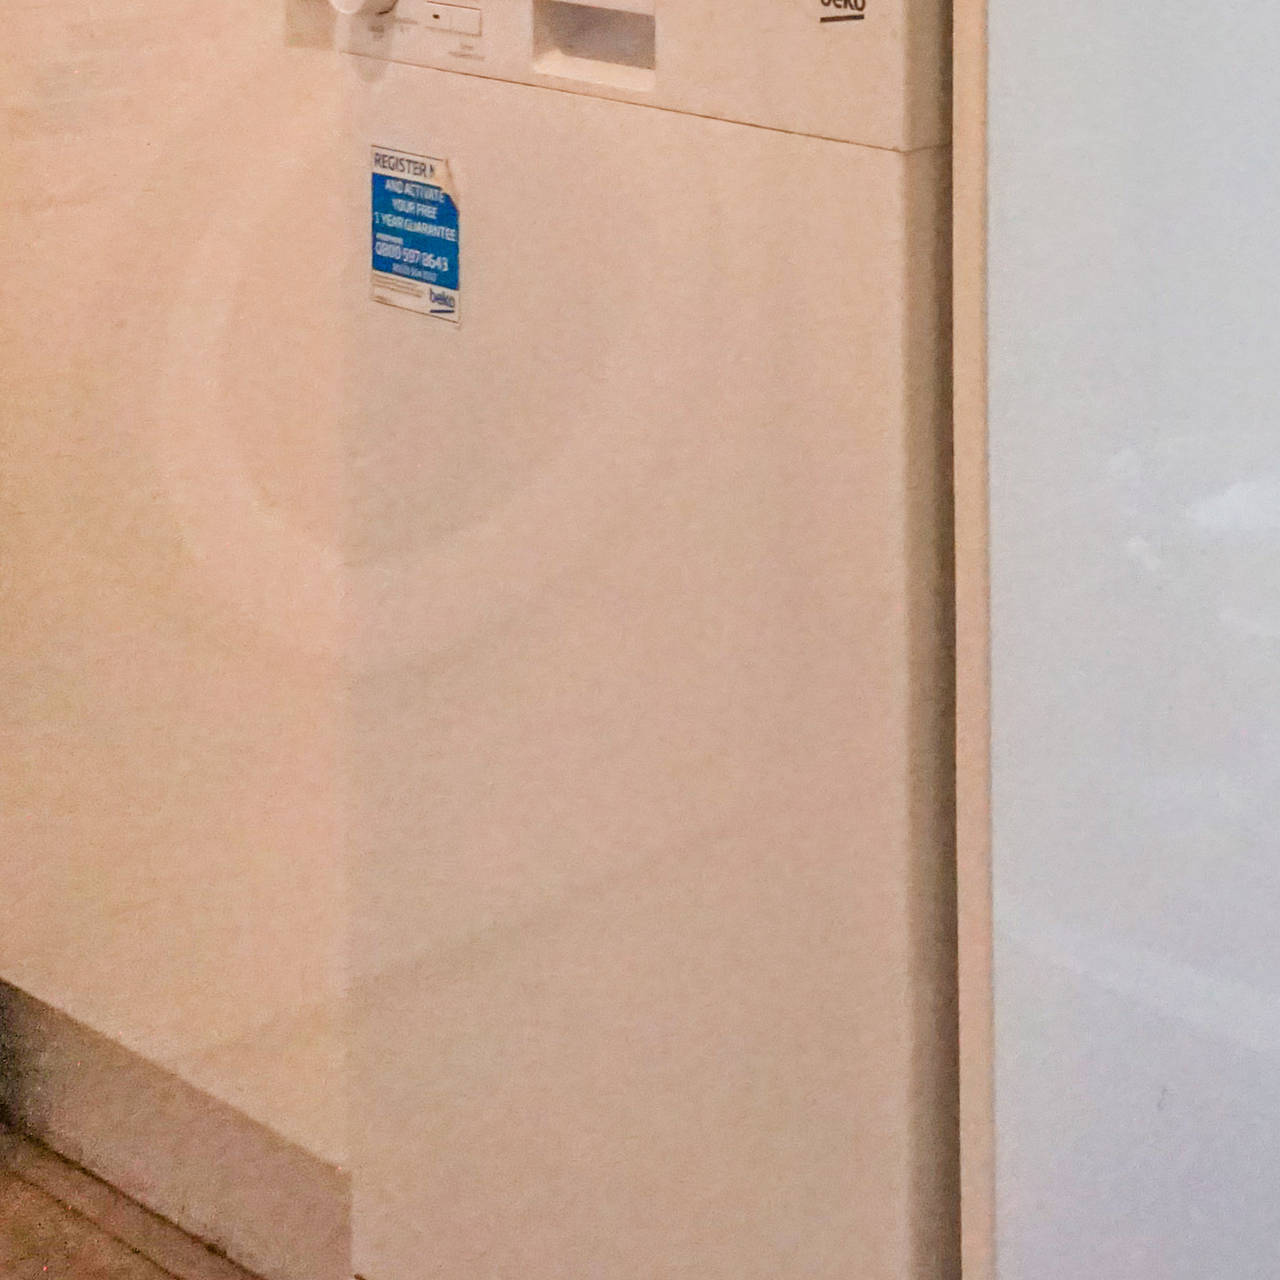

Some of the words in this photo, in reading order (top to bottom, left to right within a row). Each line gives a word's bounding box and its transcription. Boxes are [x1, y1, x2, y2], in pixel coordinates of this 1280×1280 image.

[374, 152, 427, 178] REGISTER
[385, 179, 404, 194] AND
[404, 183, 445, 203] ACTIVATE
[392, 198, 416, 216] YOUR
[416, 203, 438, 220] FREE
[380, 213, 404, 229] YEAR
[404, 217, 457, 242] GUARANTEE
[430, 288, 456, 308] beko
